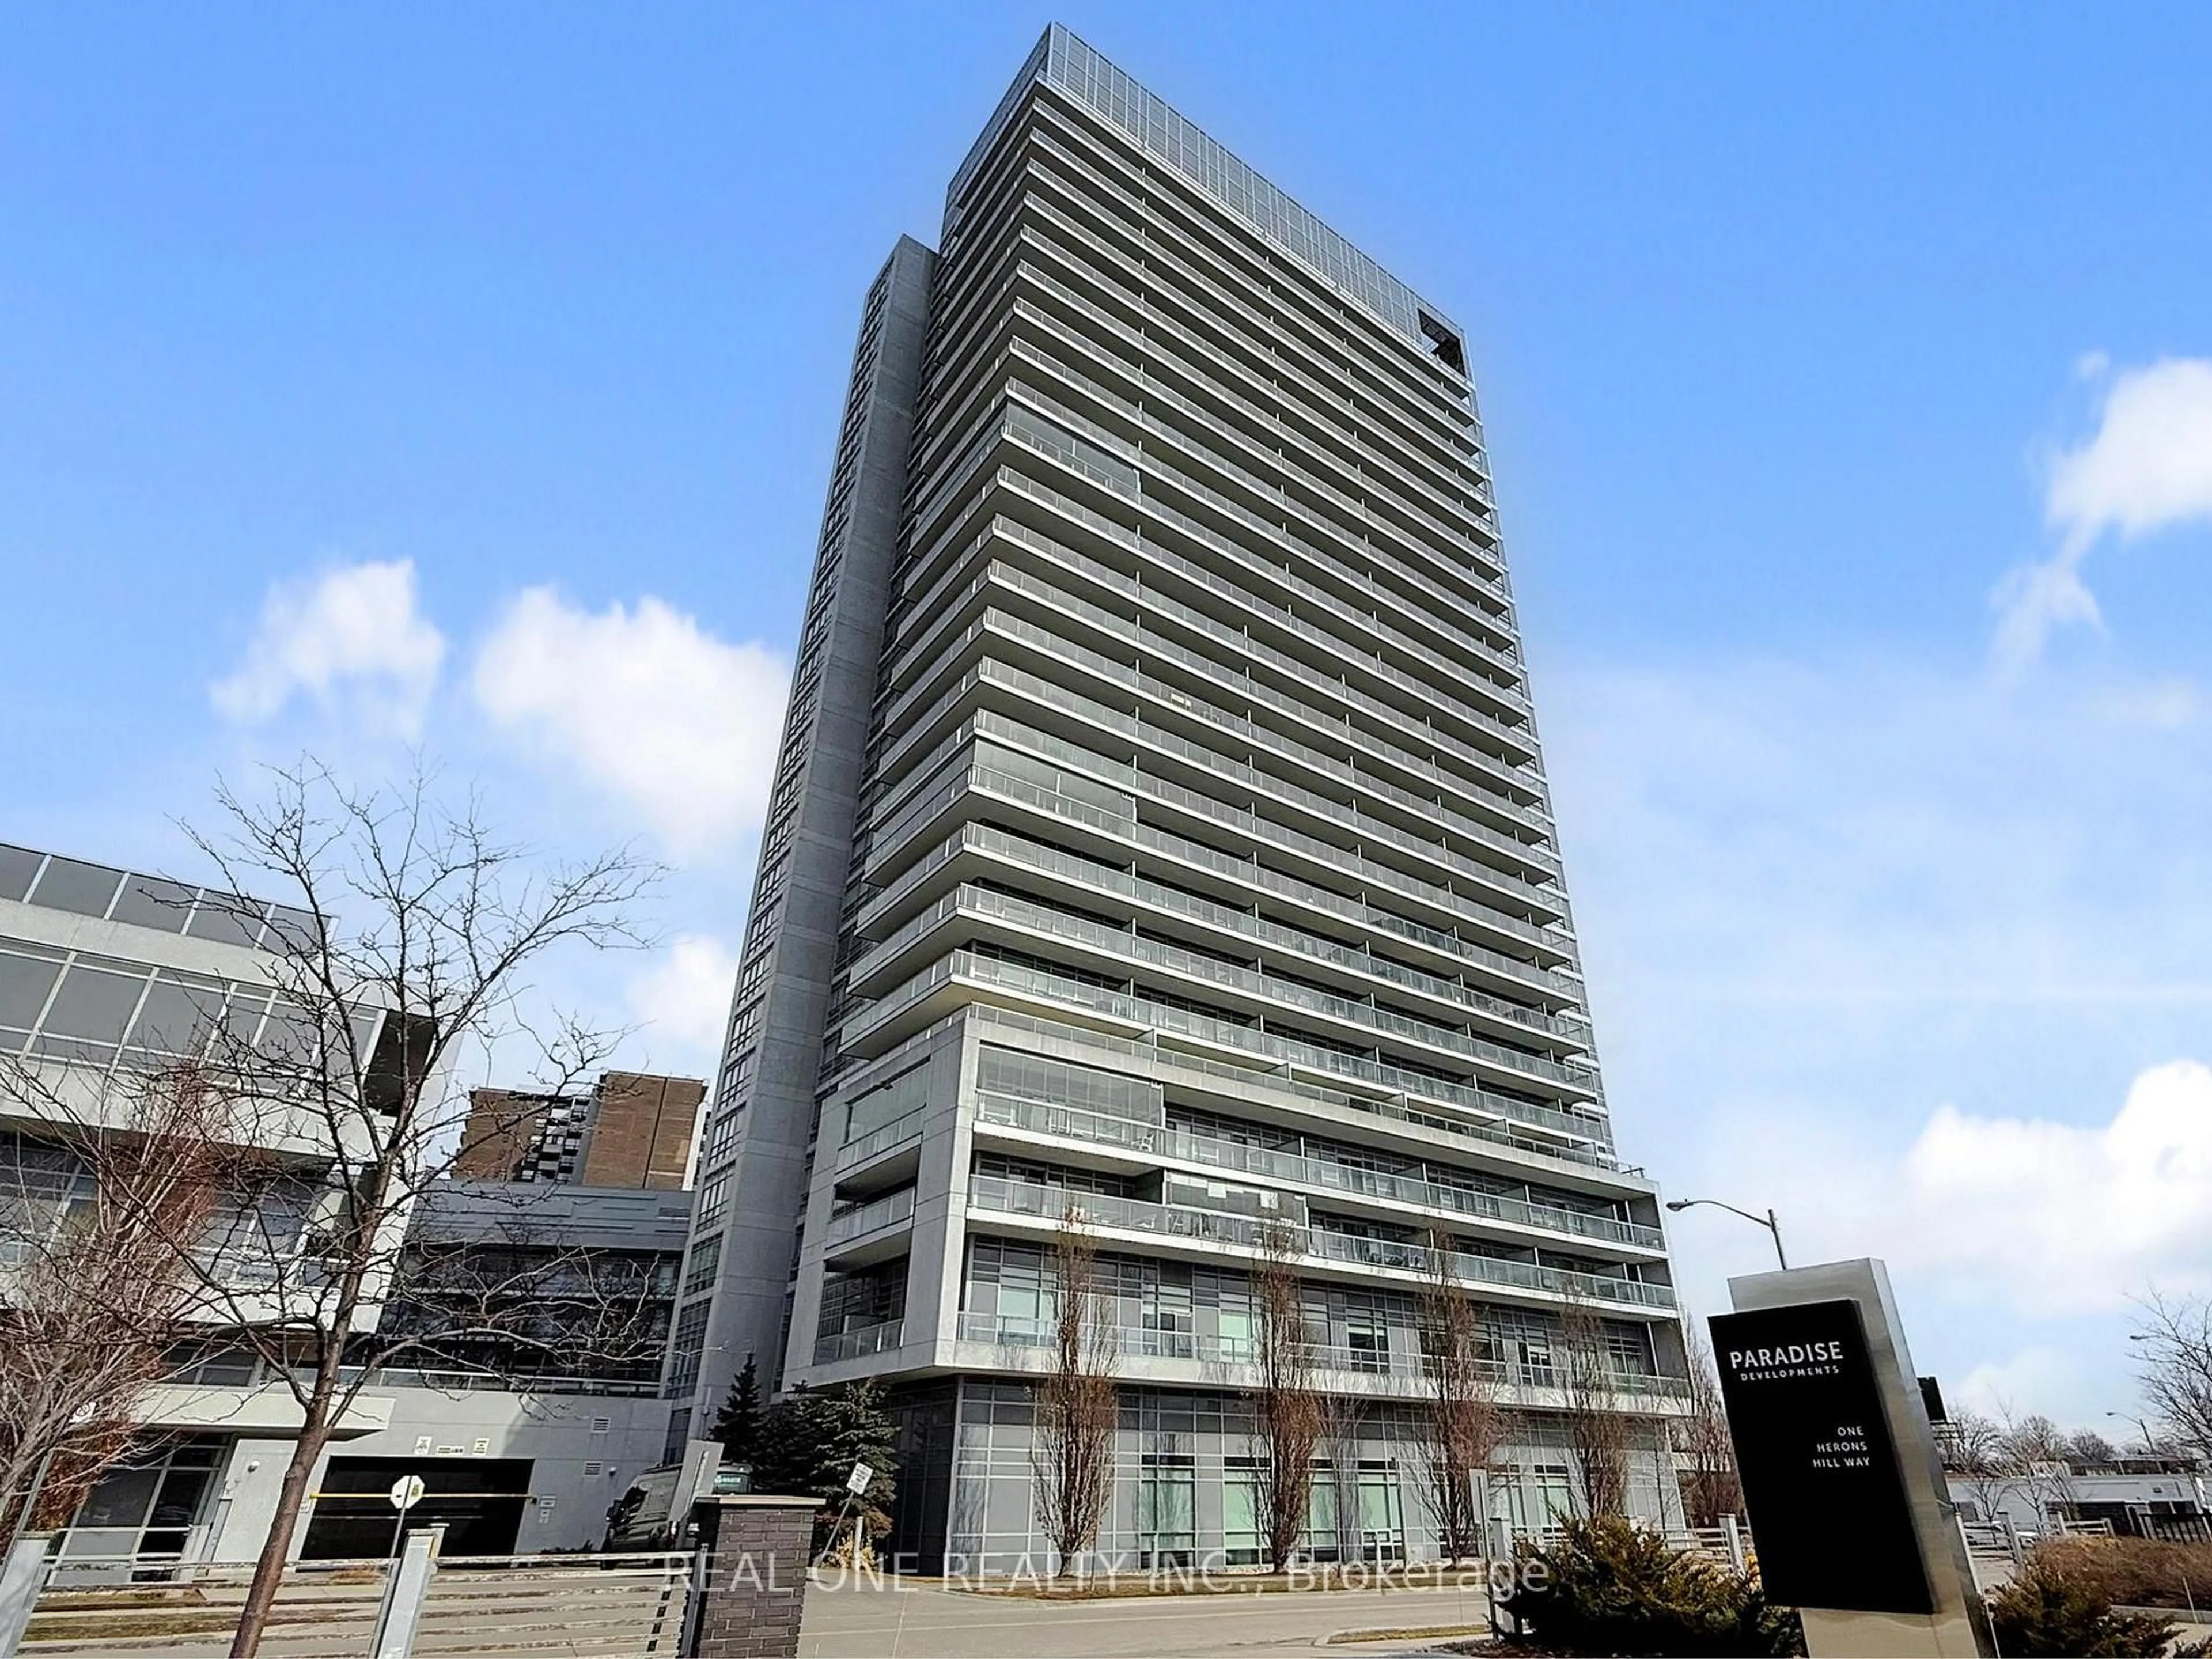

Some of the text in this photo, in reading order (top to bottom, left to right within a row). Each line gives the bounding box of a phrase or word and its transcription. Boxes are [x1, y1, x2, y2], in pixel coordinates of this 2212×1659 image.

[1730, 1341, 1843, 1369] PARADISE
[1740, 1365, 1839, 1381] DEVELOPMENTS
[1837, 1426, 1864, 1437] ONE
[1816, 1441, 1868, 1453] HERONS
[1812, 1456, 1870, 1468] HILL WAY
